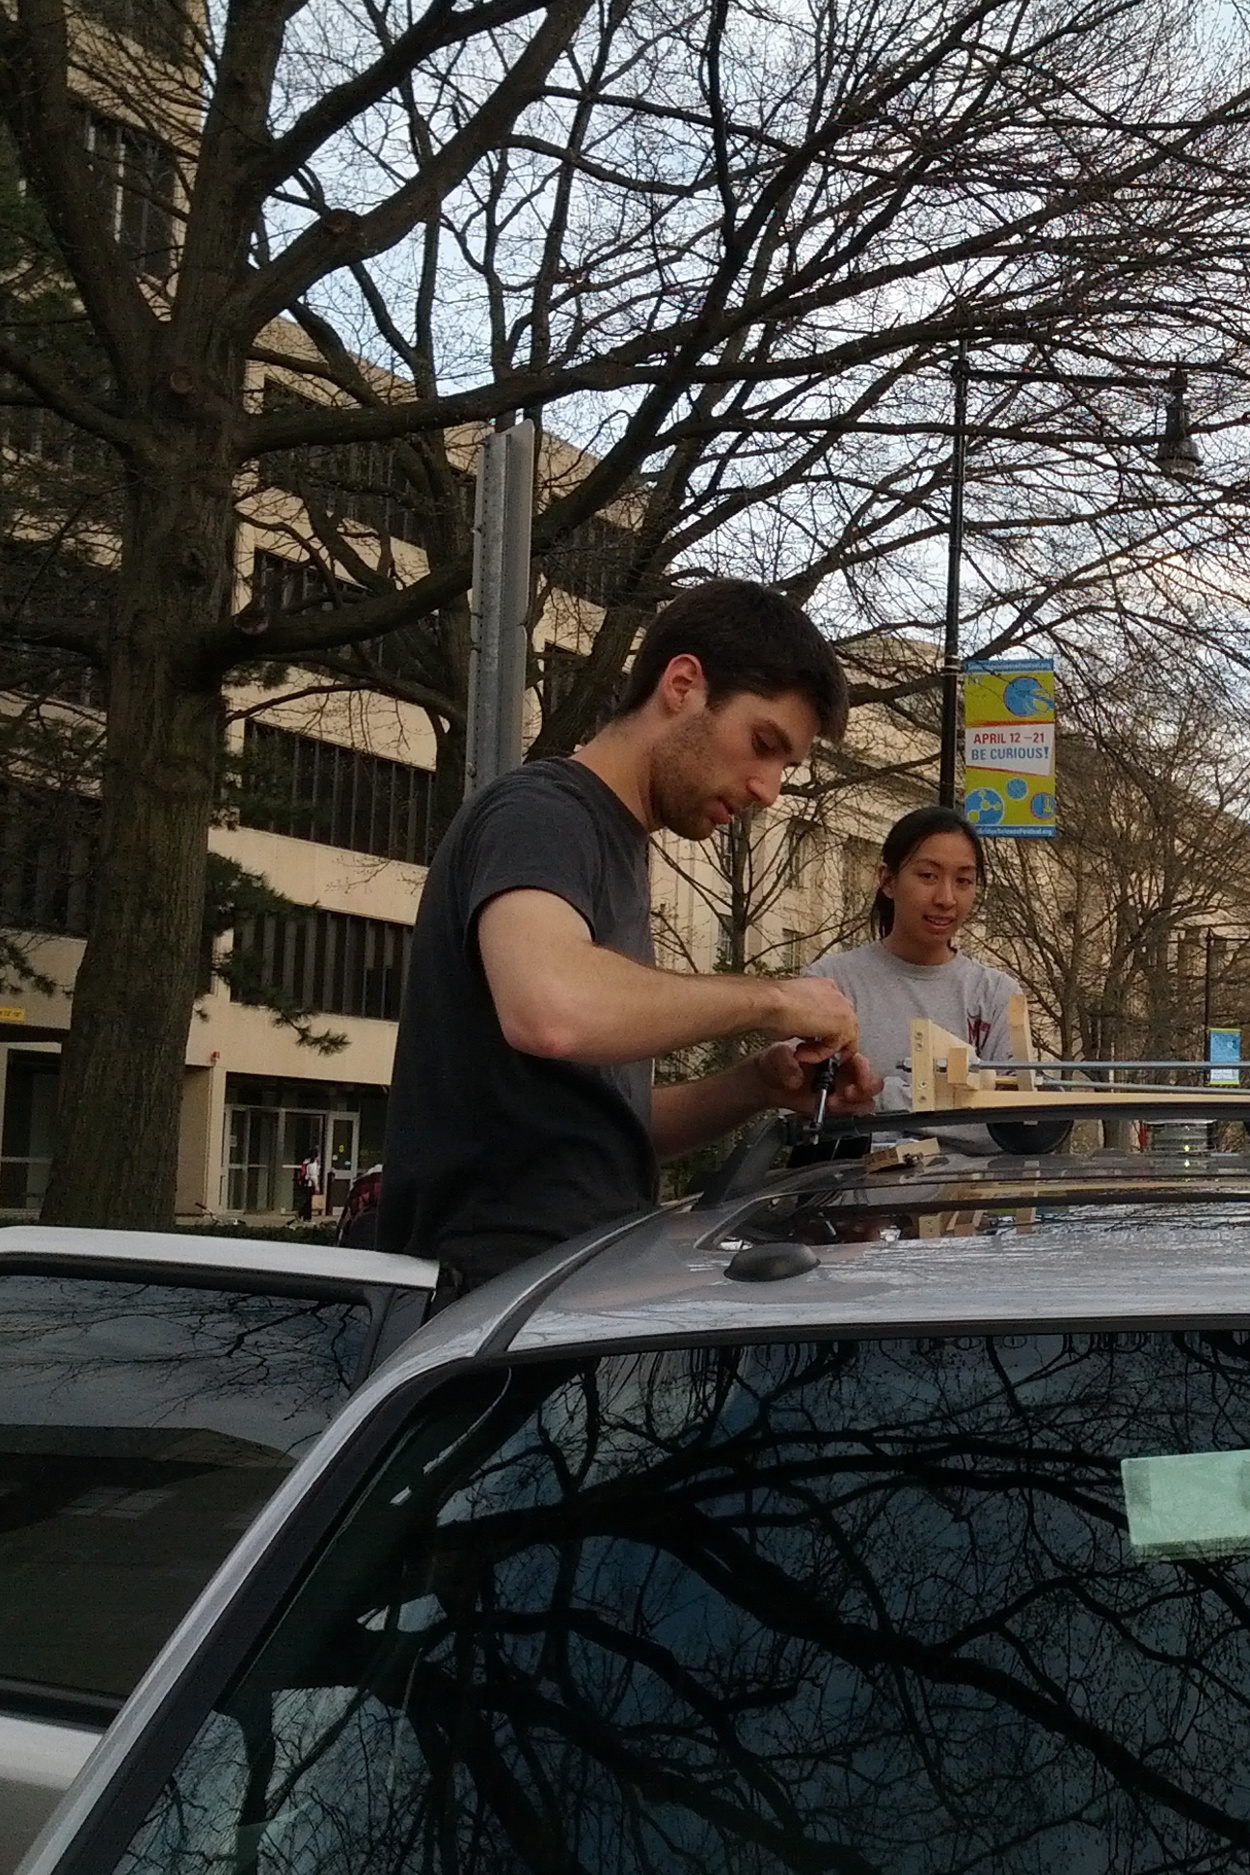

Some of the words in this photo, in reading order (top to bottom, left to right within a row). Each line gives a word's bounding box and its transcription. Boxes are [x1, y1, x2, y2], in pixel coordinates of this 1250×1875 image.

[973, 732, 1006, 744] APRIL
[1009, 732, 1021, 742] 12
[971, 748, 986, 761] BE
[990, 746, 1049, 760] CURIOUS!
